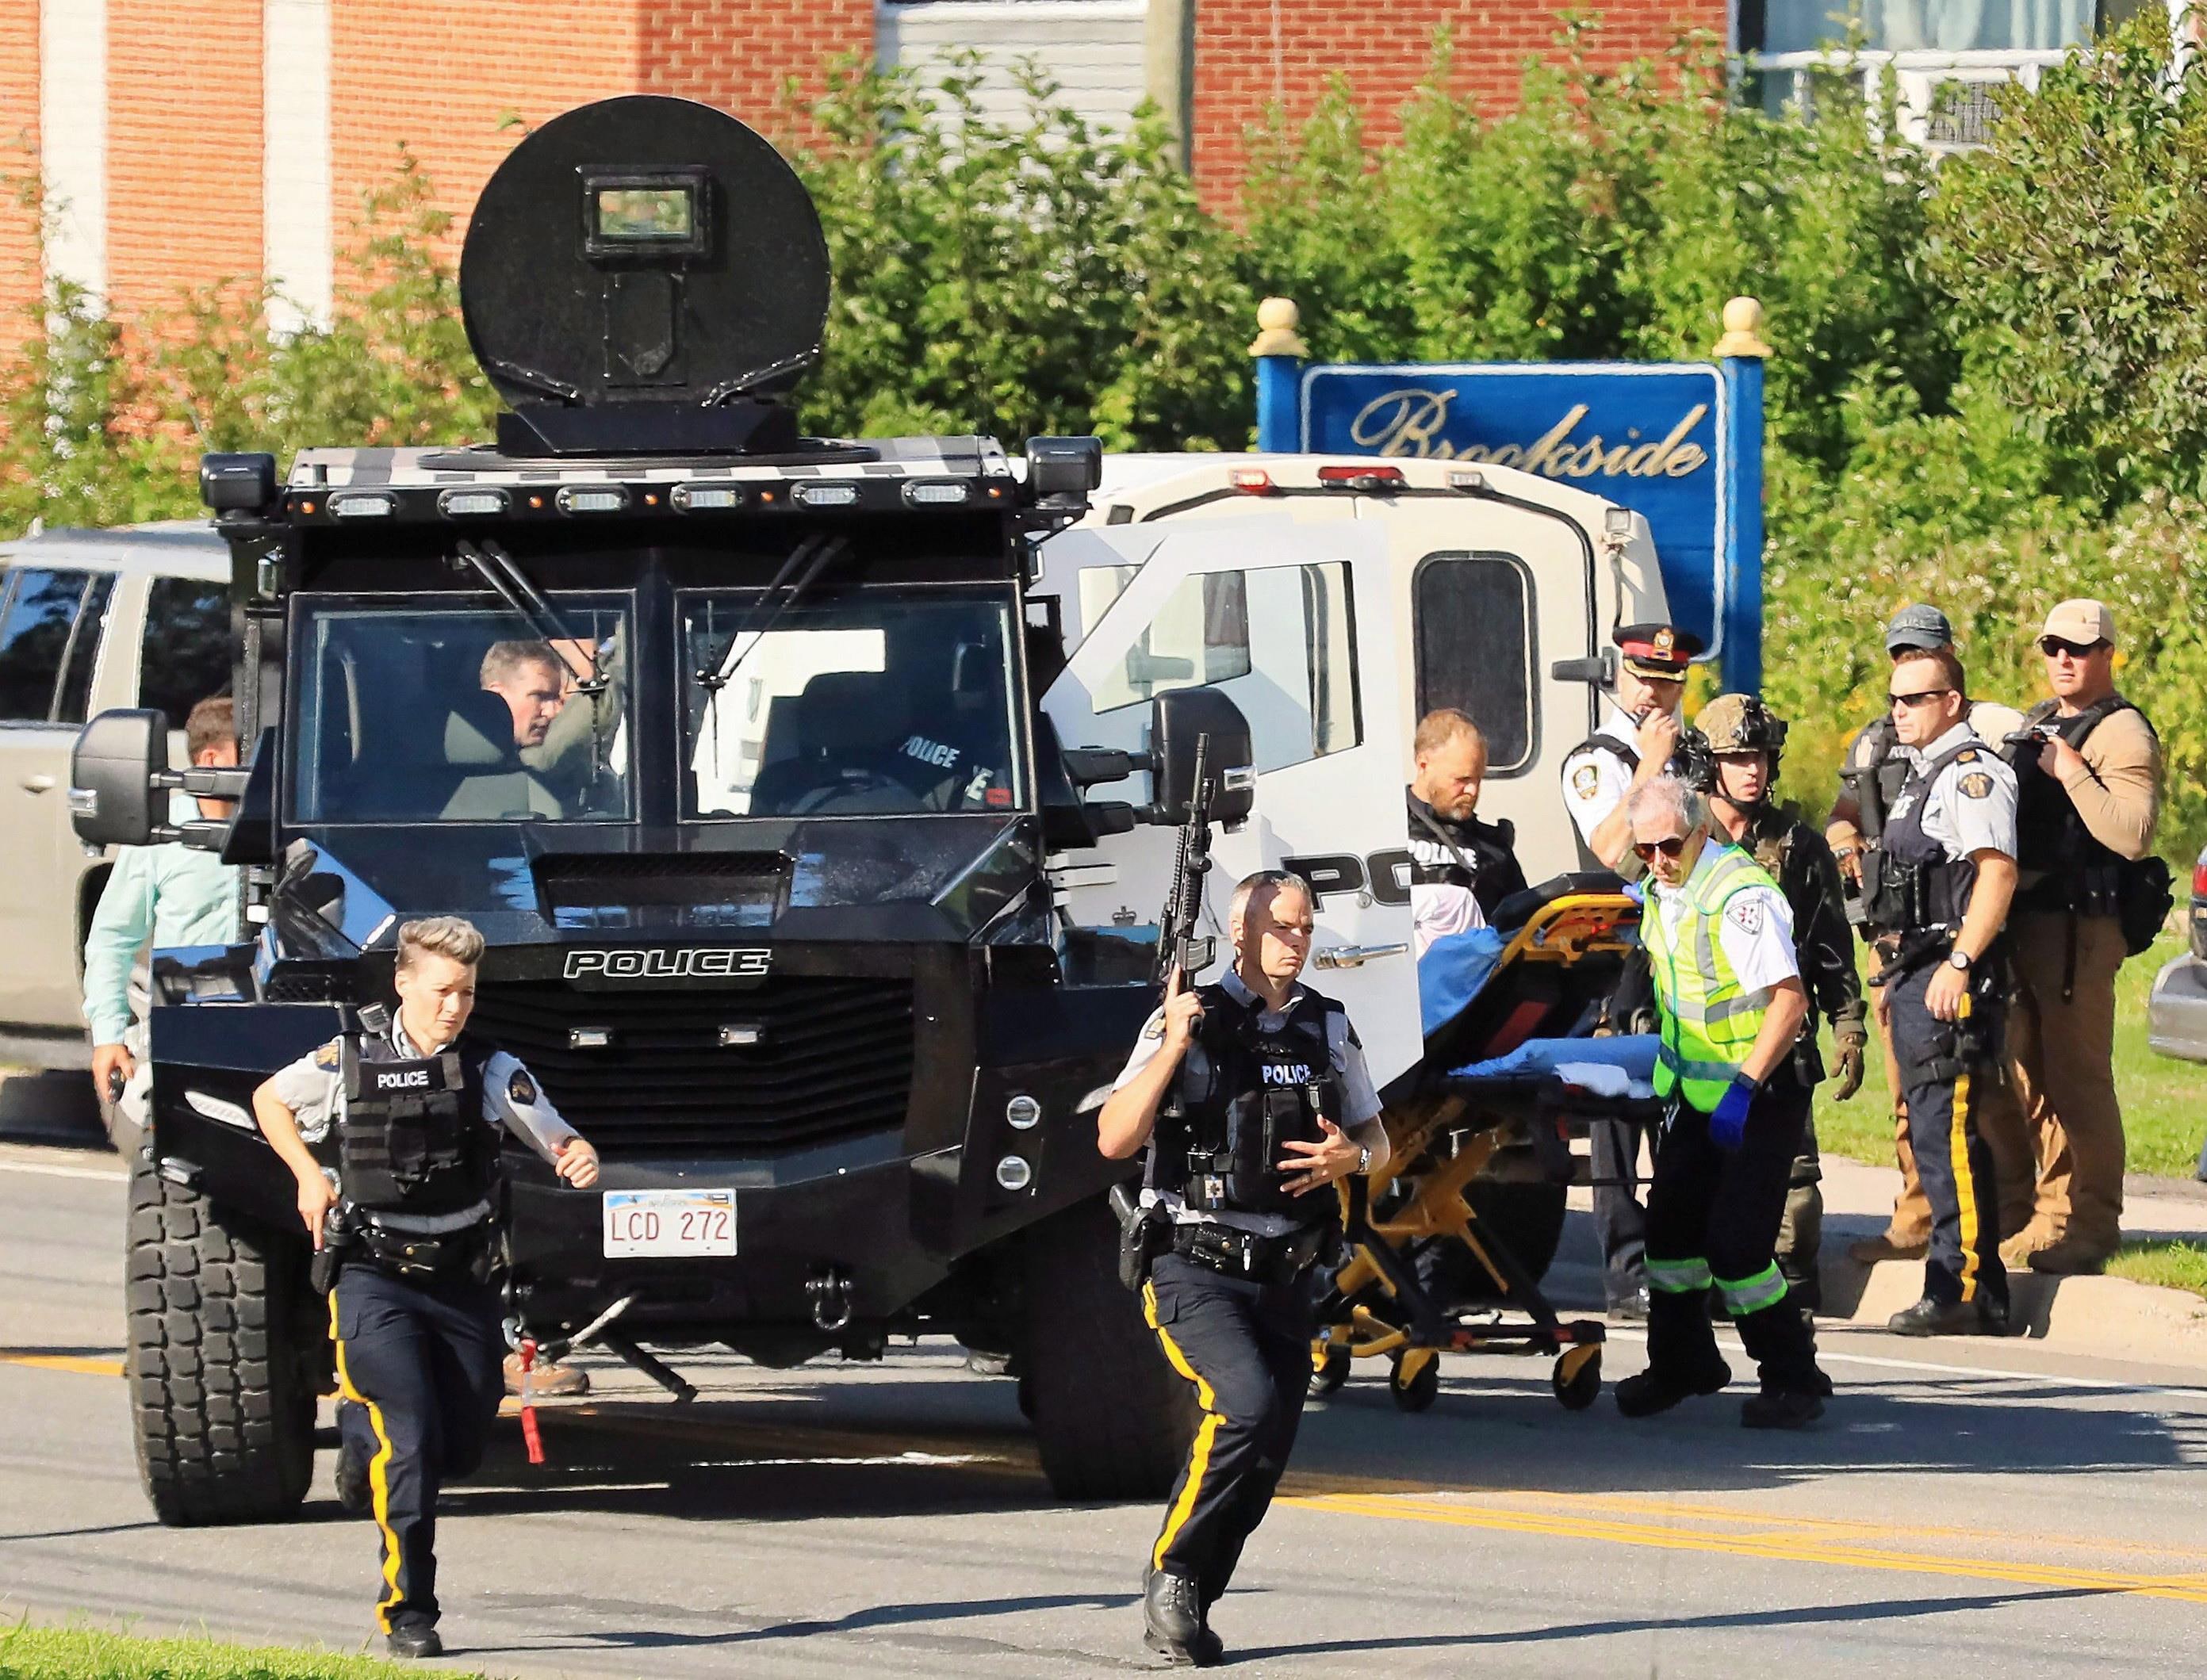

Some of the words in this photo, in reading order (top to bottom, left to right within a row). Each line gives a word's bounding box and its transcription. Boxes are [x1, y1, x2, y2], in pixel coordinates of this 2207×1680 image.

[1351, 388, 1708, 477] Brookside
[563, 948, 773, 978] POLICE
[377, 1070, 429, 1089] POLICE
[1262, 1064, 1311, 1085] POLICE
[611, 1212, 659, 1241] LCD
[680, 1211, 728, 1241] 272
